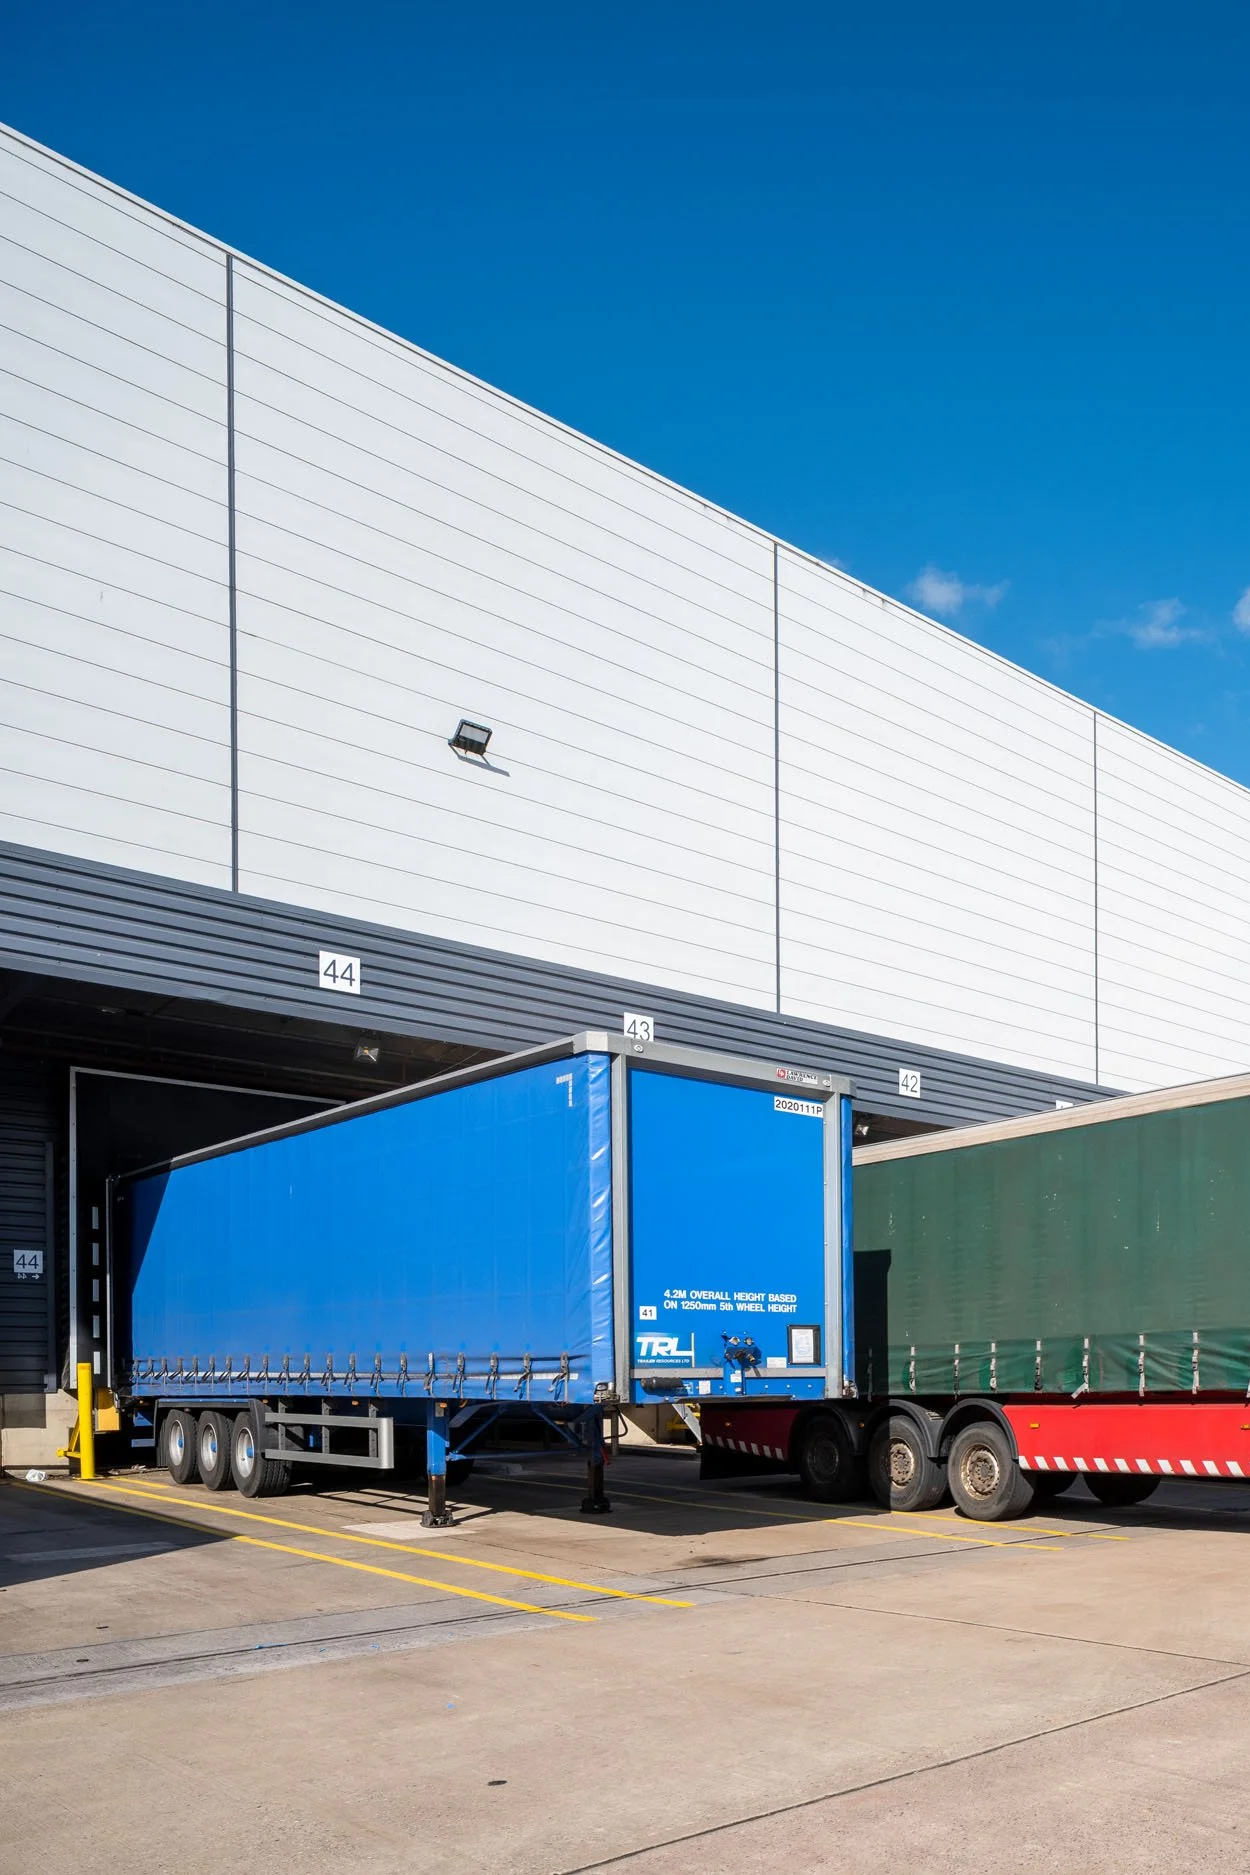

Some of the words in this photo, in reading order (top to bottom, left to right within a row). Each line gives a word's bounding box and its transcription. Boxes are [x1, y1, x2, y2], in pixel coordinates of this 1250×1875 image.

[323, 959, 356, 987] 44
[627, 1019, 651, 1041] 43
[787, 1070, 817, 1080] LAWRENCE
[901, 1074, 918, 1093] 42
[775, 1099, 823, 1115] 2020111P
[15, 1254, 39, 1269] 44
[663, 1289, 687, 1299] 4.2M
[690, 1290, 731, 1300] OVERALL
[734, 1292, 766, 1302] HEIGHT
[768, 1293, 797, 1303] BASED
[641, 1308, 653, 1317] 41
[663, 1300, 678, 1309] ON
[681, 1300, 717, 1311] 1250mm
[719, 1302, 734, 1311] 5th
[736, 1303, 766, 1313] WHEEL
[768, 1304, 798, 1313] HEIGHT
[636, 1336, 693, 1357] TRL
